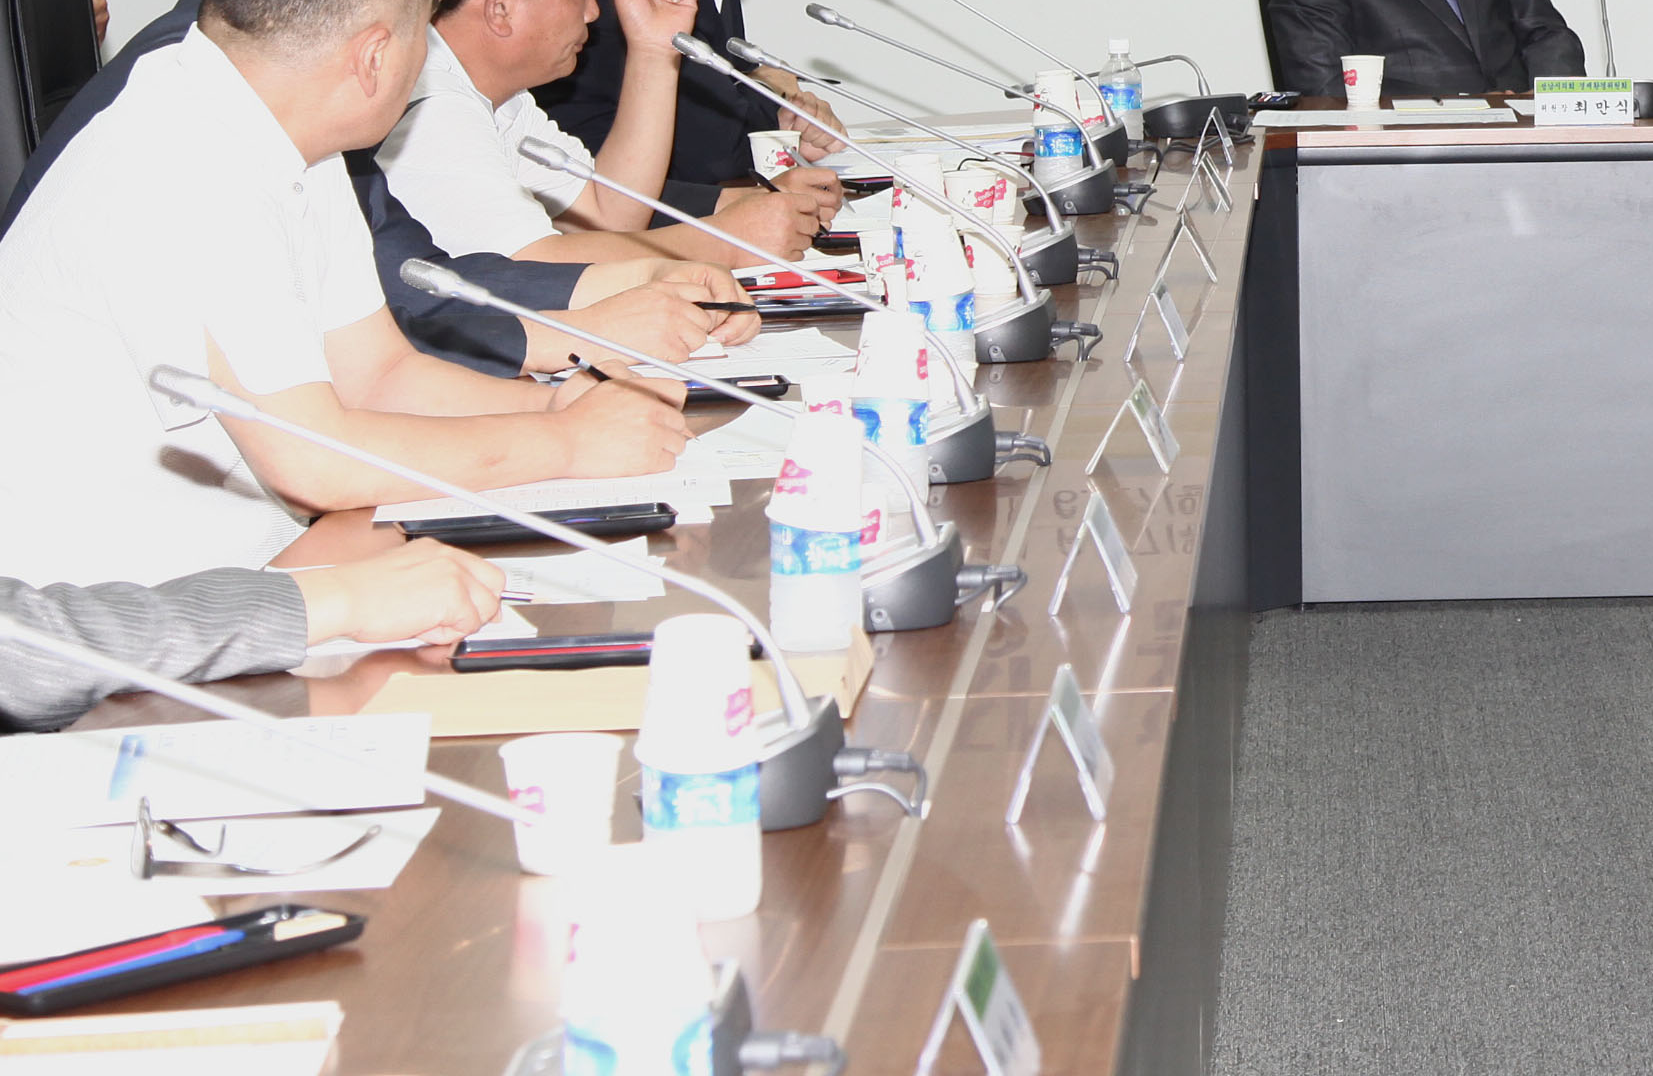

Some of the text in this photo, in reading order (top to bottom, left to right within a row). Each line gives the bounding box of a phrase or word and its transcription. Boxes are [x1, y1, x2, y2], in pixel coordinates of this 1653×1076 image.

[1541, 82, 1575, 91] 성남시의회
[1541, 99, 1629, 116] 위원장 최만식
